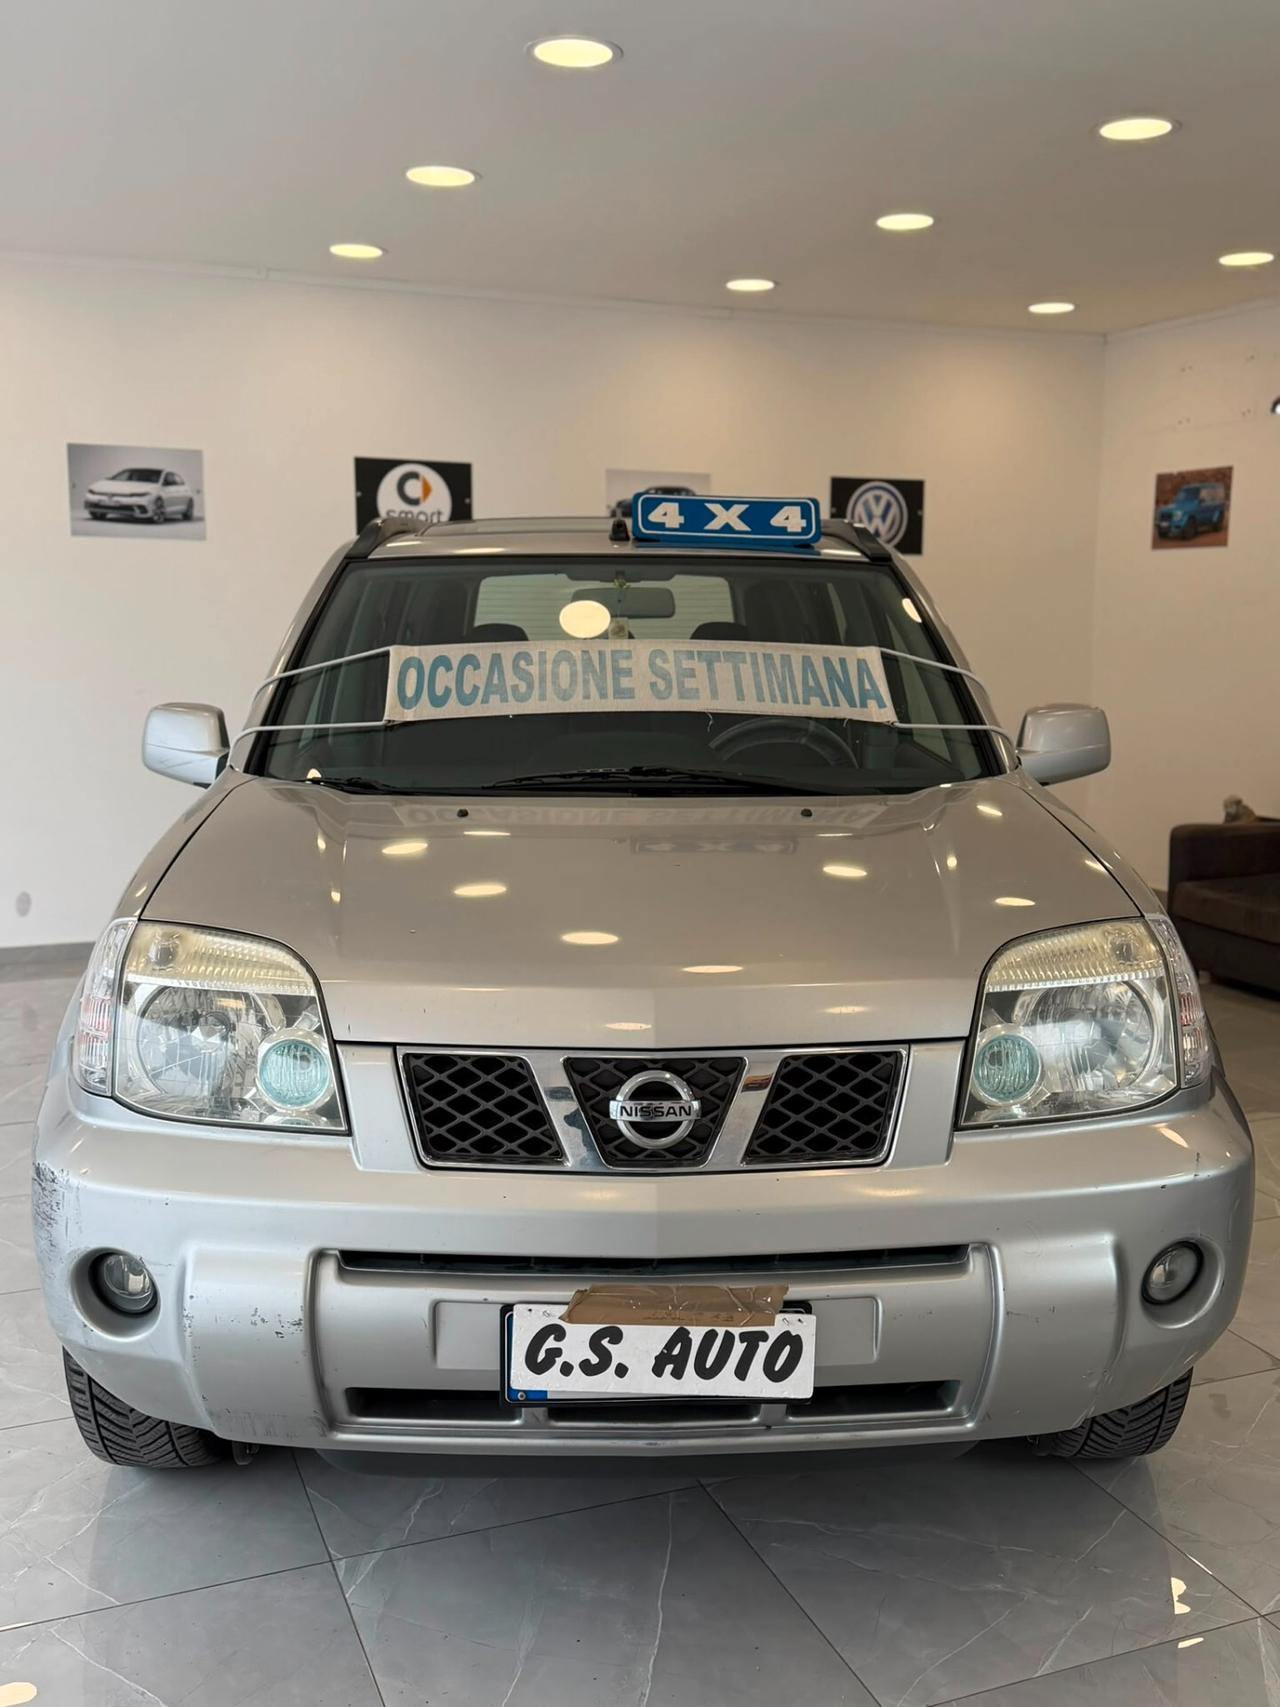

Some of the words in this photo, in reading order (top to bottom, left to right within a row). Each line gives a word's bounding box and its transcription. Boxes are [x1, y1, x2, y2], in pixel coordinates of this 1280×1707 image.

[397, 649, 635, 710] OCCASIONE
[648, 648, 887, 709] SETTIMANA
[620, 1105, 692, 1118] NISSAN
[525, 1323, 629, 1379] G.S.
[651, 1326, 803, 1383] AUTO
